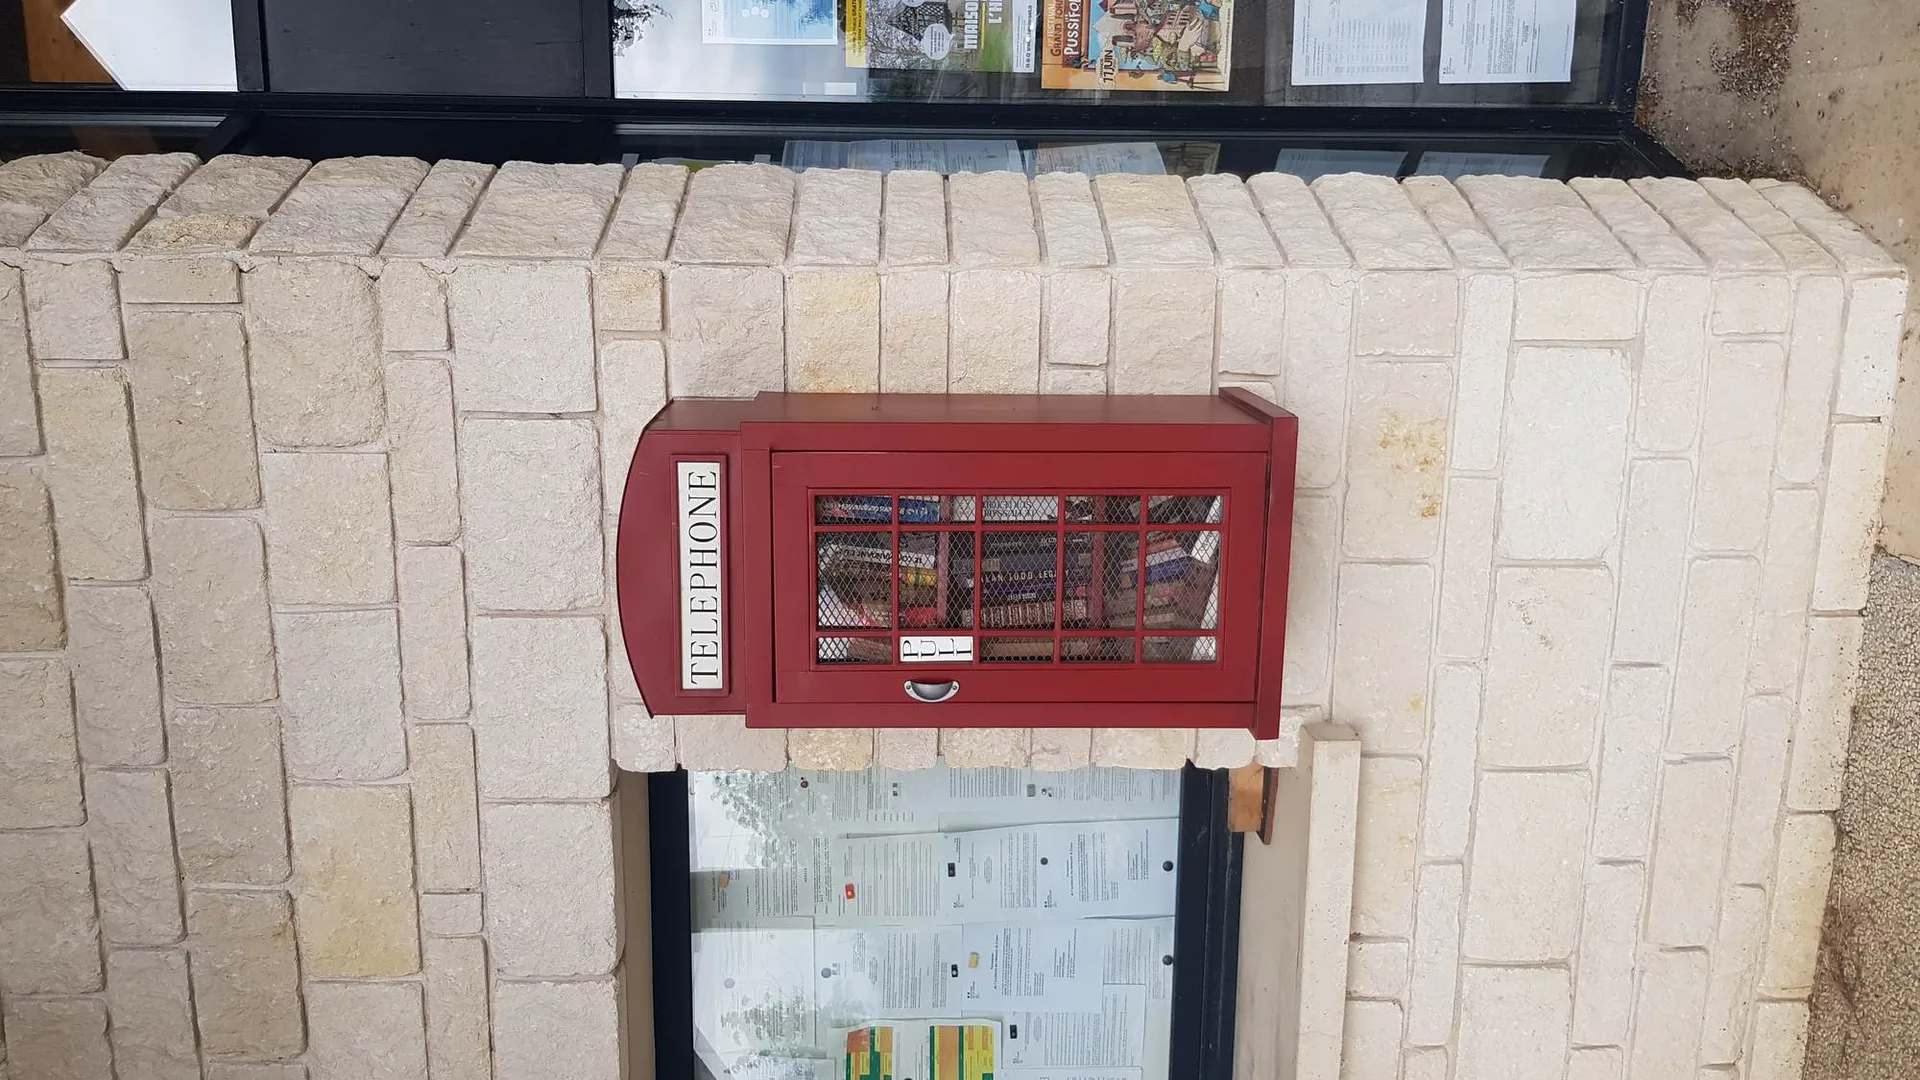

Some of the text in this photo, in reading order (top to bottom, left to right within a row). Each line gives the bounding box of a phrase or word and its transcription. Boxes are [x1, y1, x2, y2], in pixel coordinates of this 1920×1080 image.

[964, 0, 979, 49] MAISO
[988, 0, 1003, 24] L'H
[1050, 23, 1062, 57] GRAND
[1103, 49, 1115, 72] JUIN
[688, 470, 719, 685] TELEPHONE
[902, 638, 972, 659] PULL
